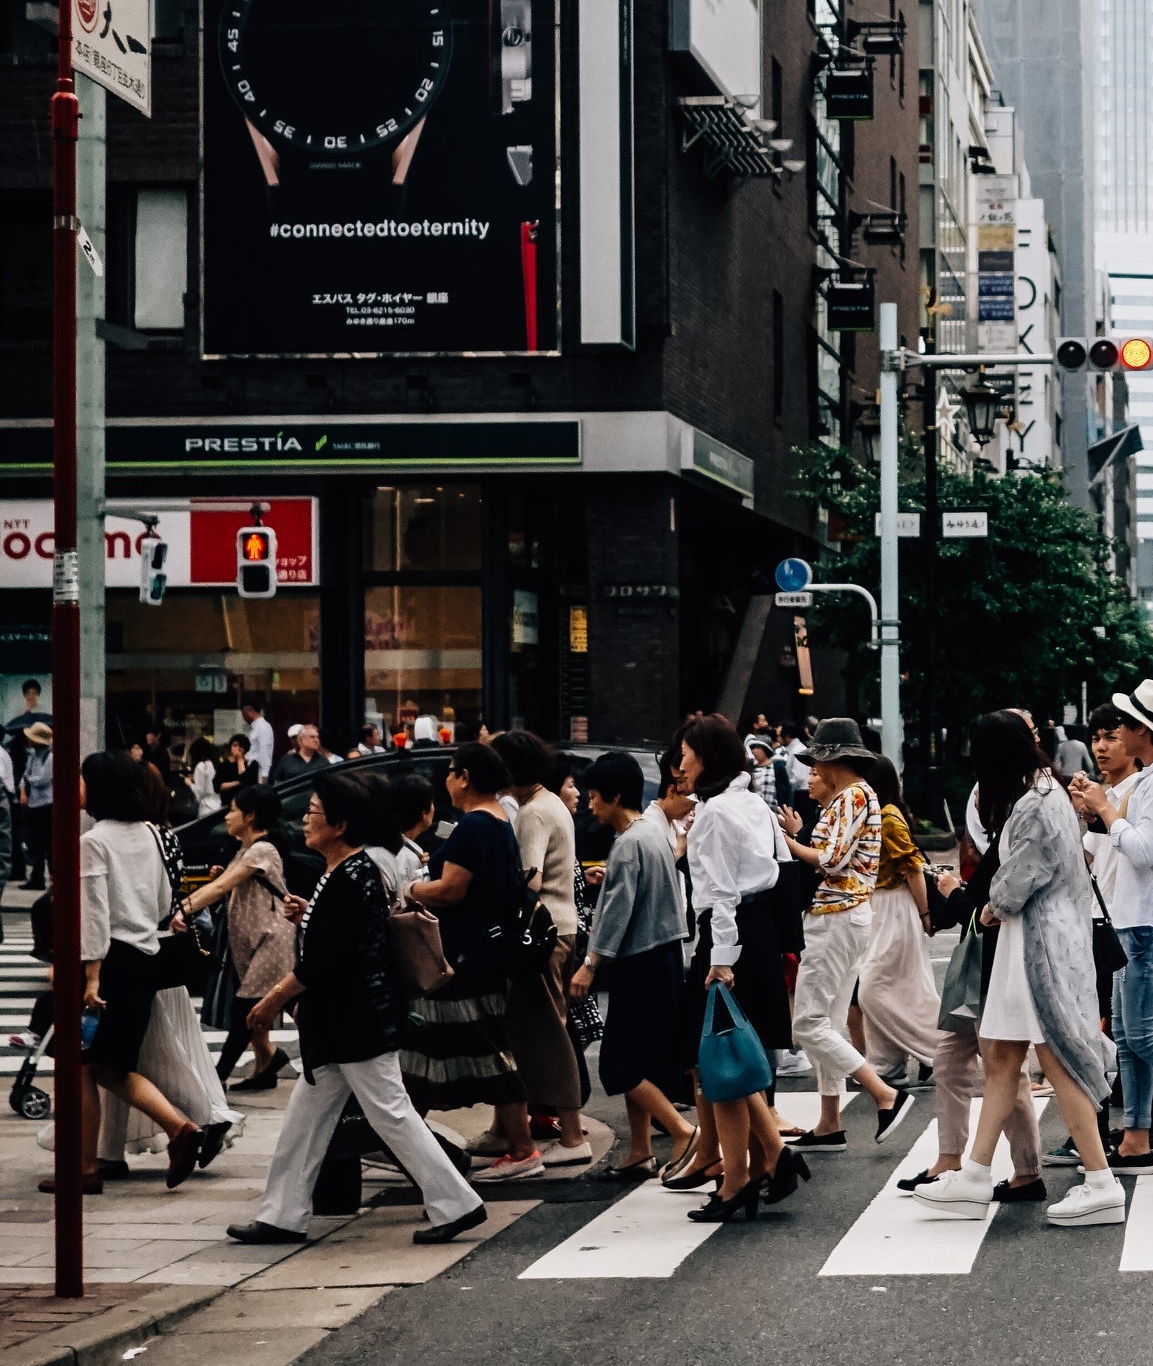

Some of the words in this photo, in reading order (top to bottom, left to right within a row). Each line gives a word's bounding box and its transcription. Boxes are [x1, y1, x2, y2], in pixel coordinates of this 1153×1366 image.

[228, 29, 239, 52] 45
[433, 30, 444, 47] 15
[237, 80, 256, 102] 40
[415, 78, 434, 102] 20
[273, 119, 296, 139] 35
[376, 118, 399, 137] 25
[324, 136, 347, 148] 30
[270, 218, 490, 239] #connectedtoeternity
[426, 292, 449, 304] 銀座
[4, 519, 31, 529] NTT
